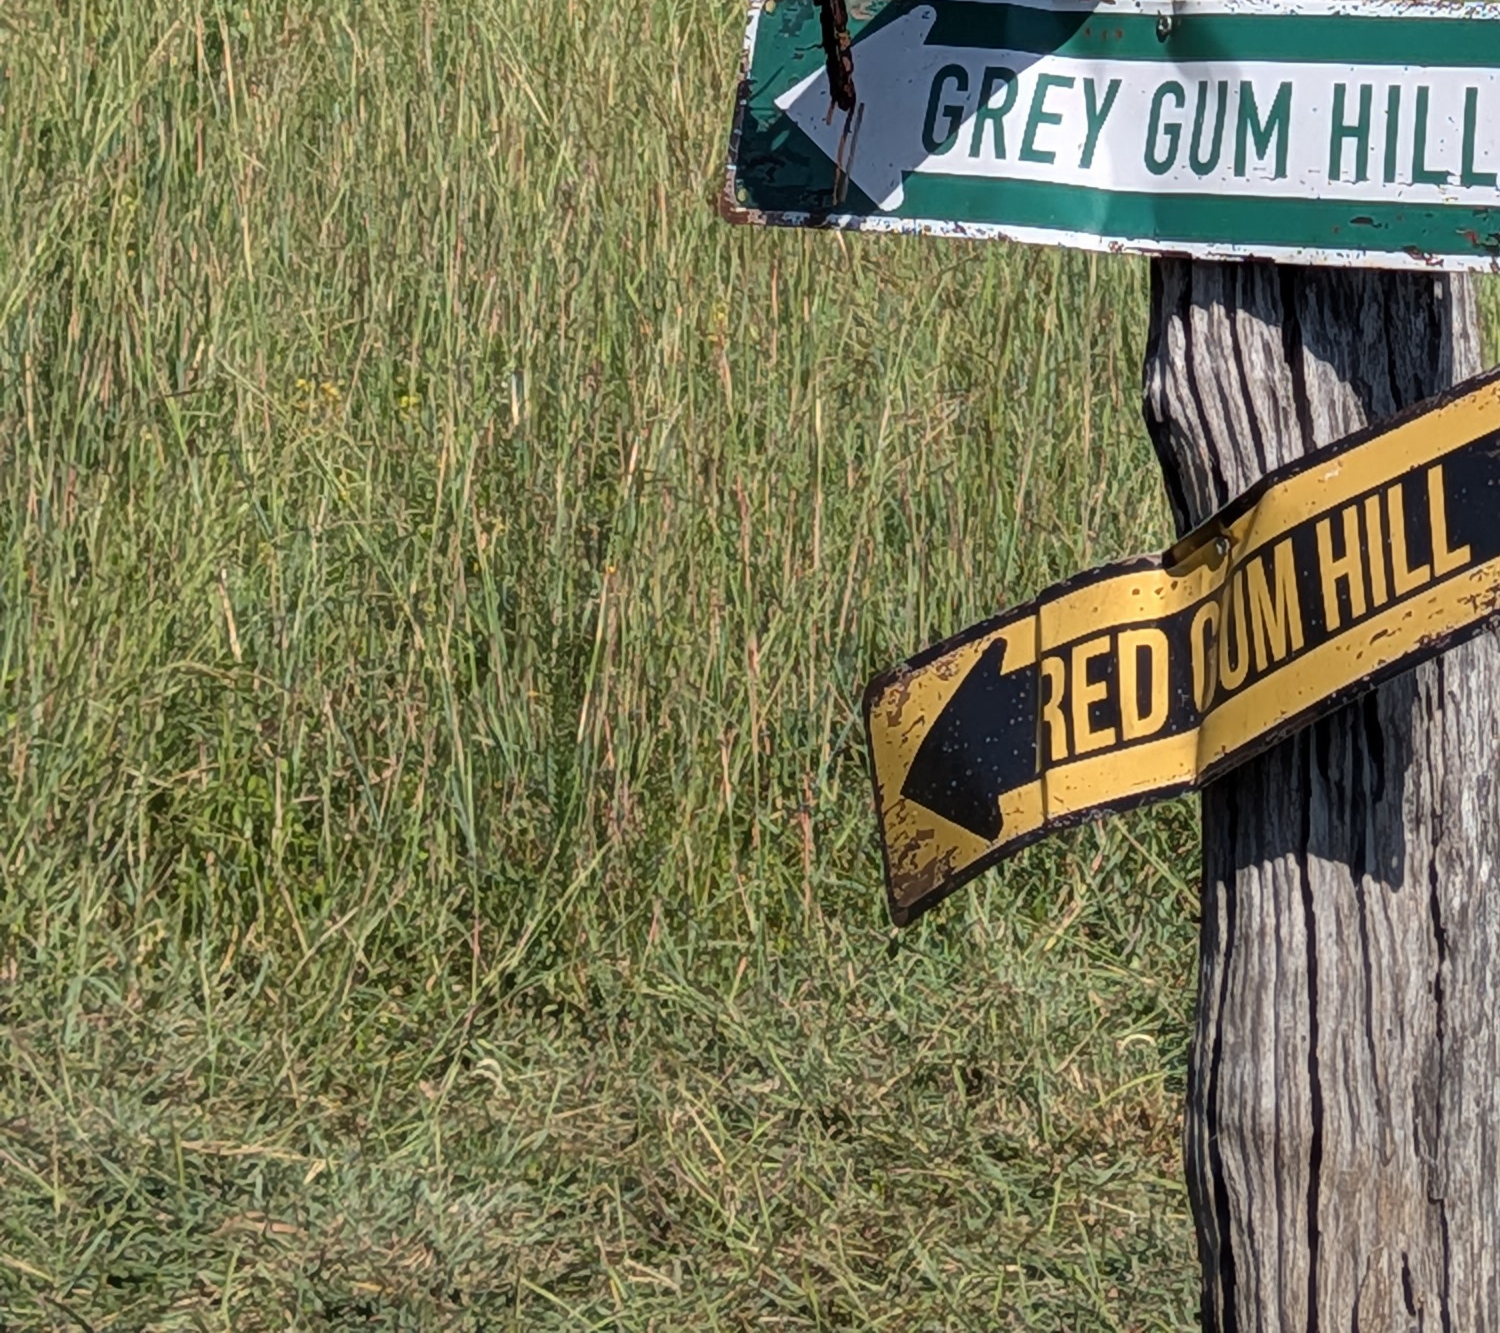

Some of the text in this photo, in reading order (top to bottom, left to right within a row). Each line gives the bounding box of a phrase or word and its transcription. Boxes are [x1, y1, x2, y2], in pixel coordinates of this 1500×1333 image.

[922, 62, 1498, 188] GREY GUM HILL
[1041, 627, 1169, 761] RED
[1316, 465, 1471, 631] HILL
